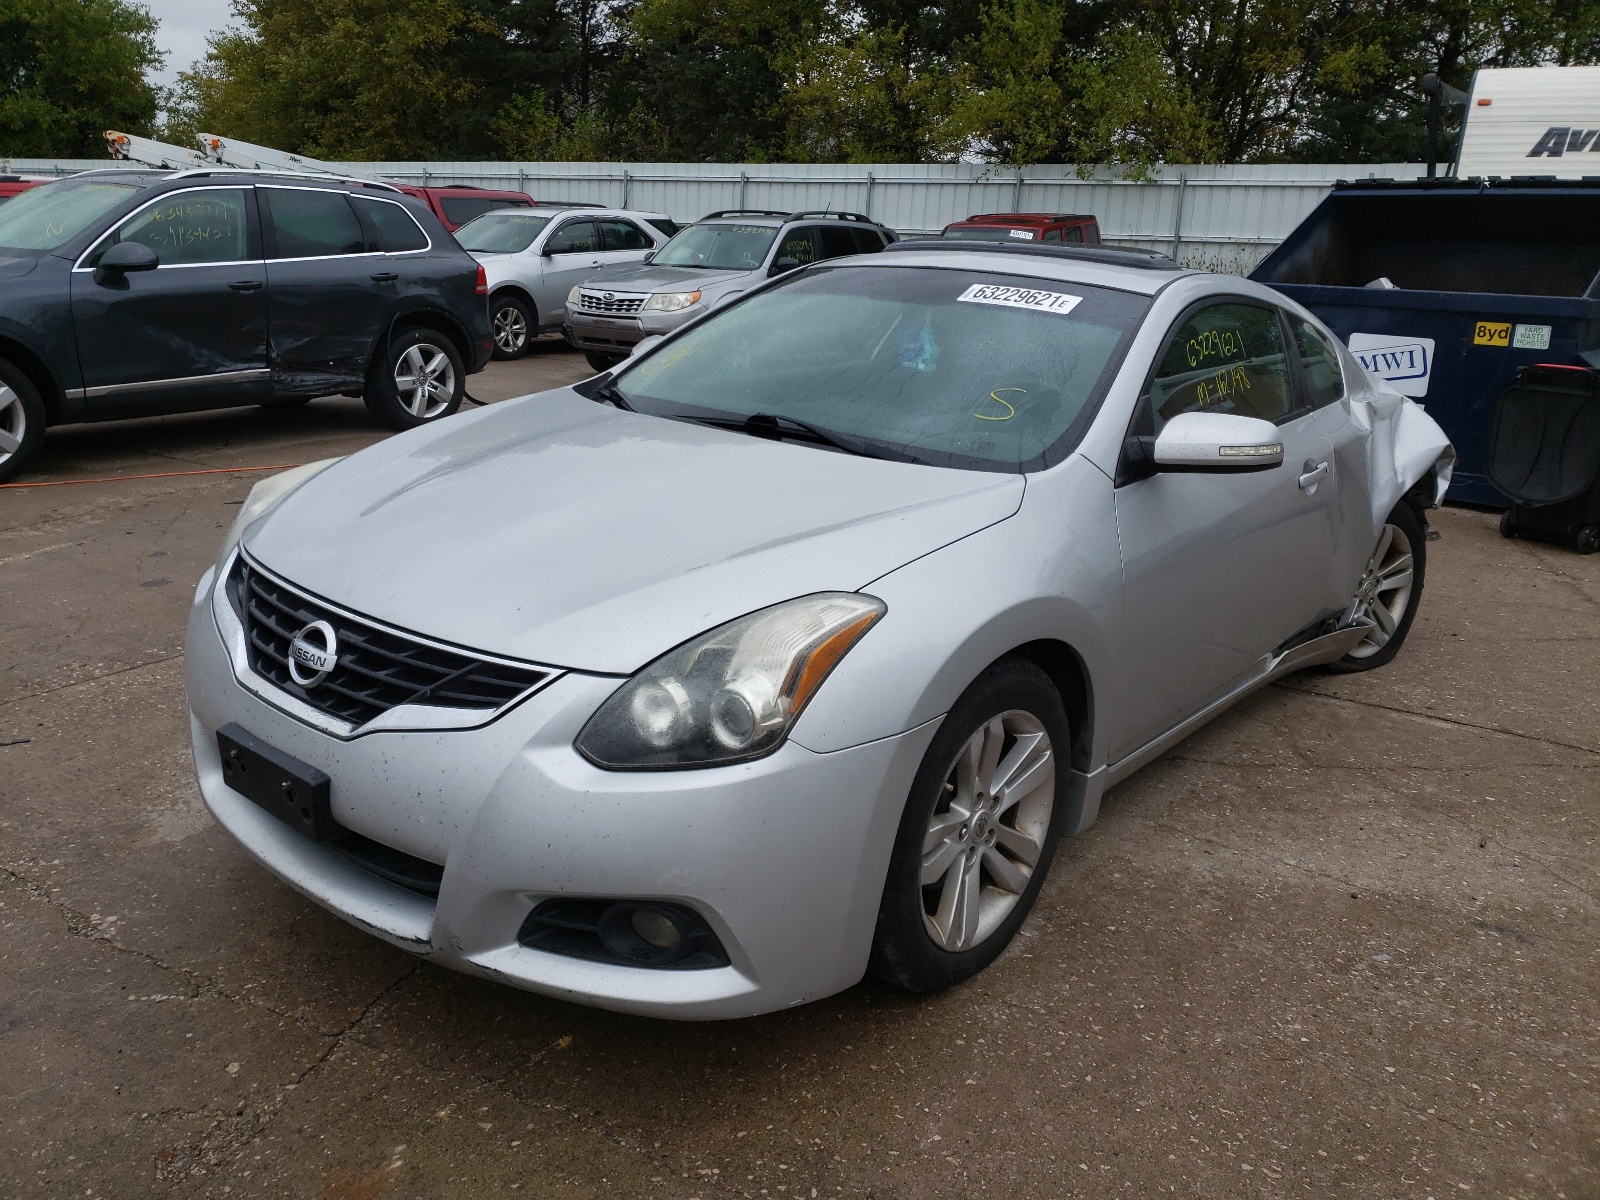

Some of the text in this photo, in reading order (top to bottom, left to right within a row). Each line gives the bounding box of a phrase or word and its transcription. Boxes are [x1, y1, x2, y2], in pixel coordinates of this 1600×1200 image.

[1476, 325, 1510, 342] 8yd
[1520, 333, 1546, 341] WASTE
[1524, 326, 1544, 334] YARD
[1187, 329, 1247, 367] 63229621
[1516, 339, 1547, 347] PROHIBITED
[1358, 350, 1417, 372] MWI
[971, 387, 1028, 421] S
[291, 642, 327, 667] NISSAN
